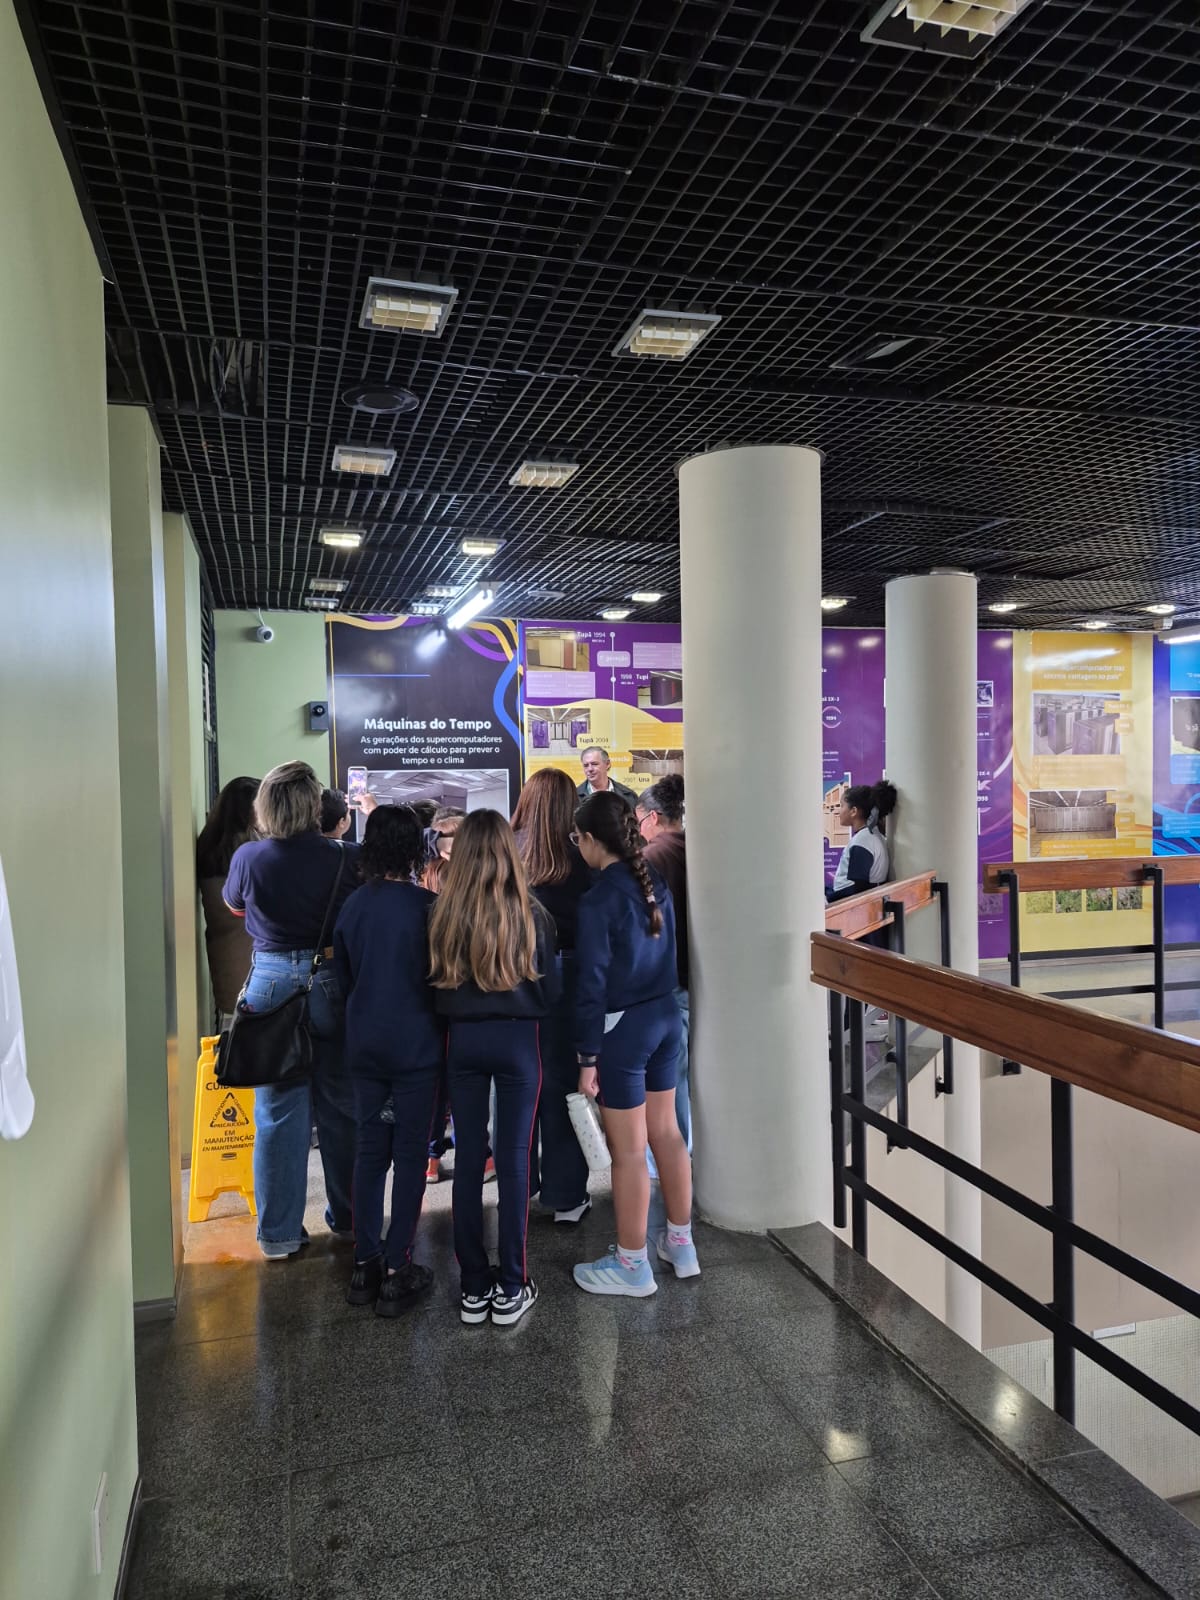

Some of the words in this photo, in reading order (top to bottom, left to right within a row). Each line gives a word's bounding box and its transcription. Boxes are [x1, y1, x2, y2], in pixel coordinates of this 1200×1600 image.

[364, 718, 427, 732] Máquinas
[429, 717, 446, 730] do
[449, 718, 492, 732] Tempo
[360, 736, 371, 744] As
[372, 735, 409, 746] gerações
[410, 735, 425, 744] dos
[426, 735, 502, 746] supercomputadores
[383, 746, 407, 756] poder
[408, 746, 419, 754] de
[421, 746, 448, 754] cálculo
[449, 747, 467, 756] para
[468, 747, 492, 756] prever
[402, 756, 428, 766] tempo
[444, 756, 465, 764] clima
[638, 775, 650, 783] Una
